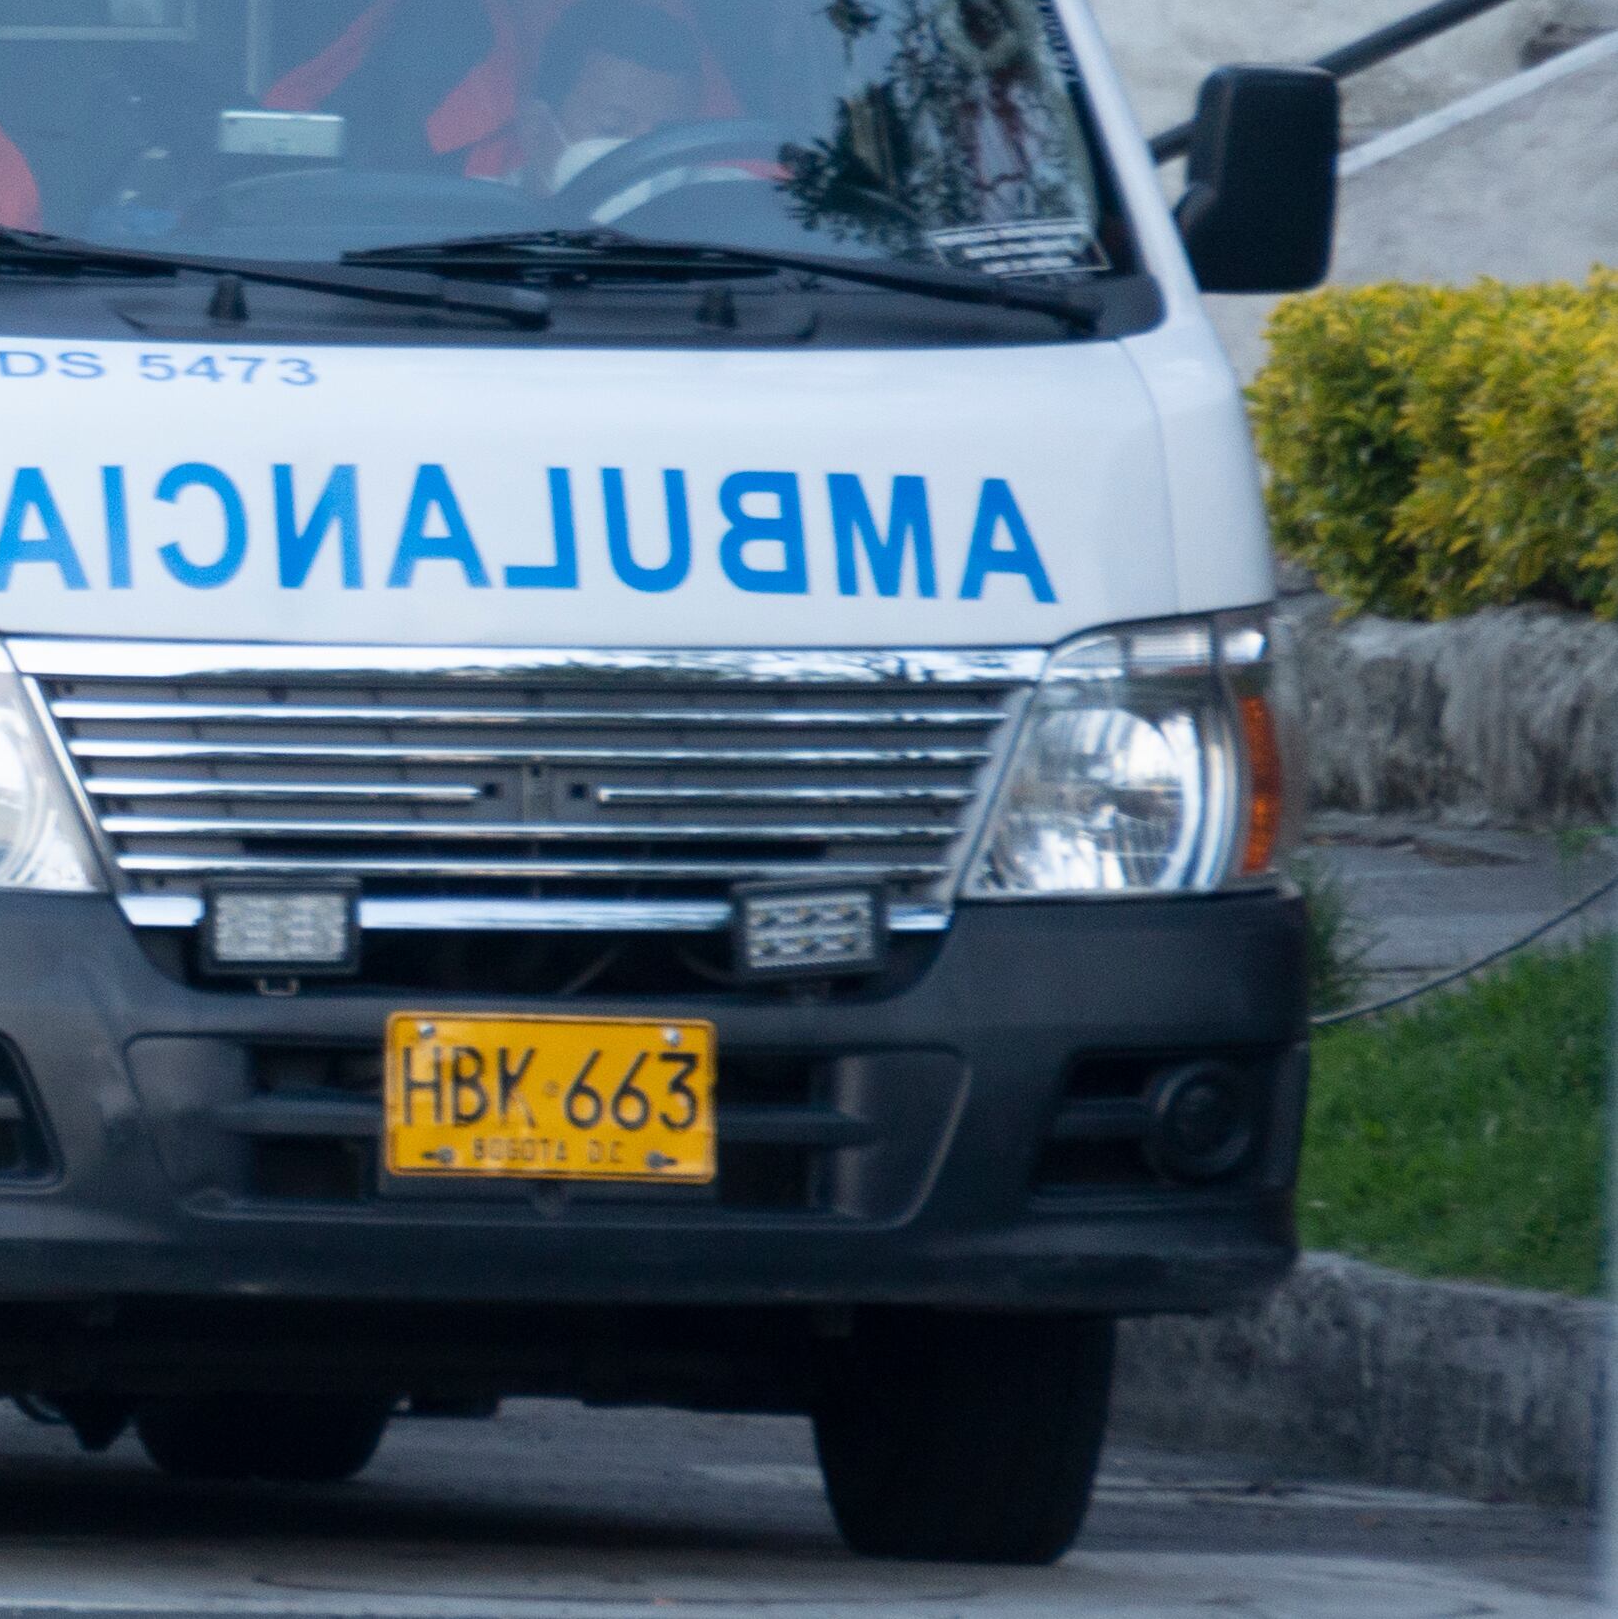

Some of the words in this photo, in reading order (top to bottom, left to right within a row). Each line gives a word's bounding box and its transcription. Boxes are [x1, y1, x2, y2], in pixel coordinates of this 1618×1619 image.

[137, 353, 319, 387] 5473
[402, 1046, 538, 1129] HBK
[564, 1049, 700, 1131] 663
